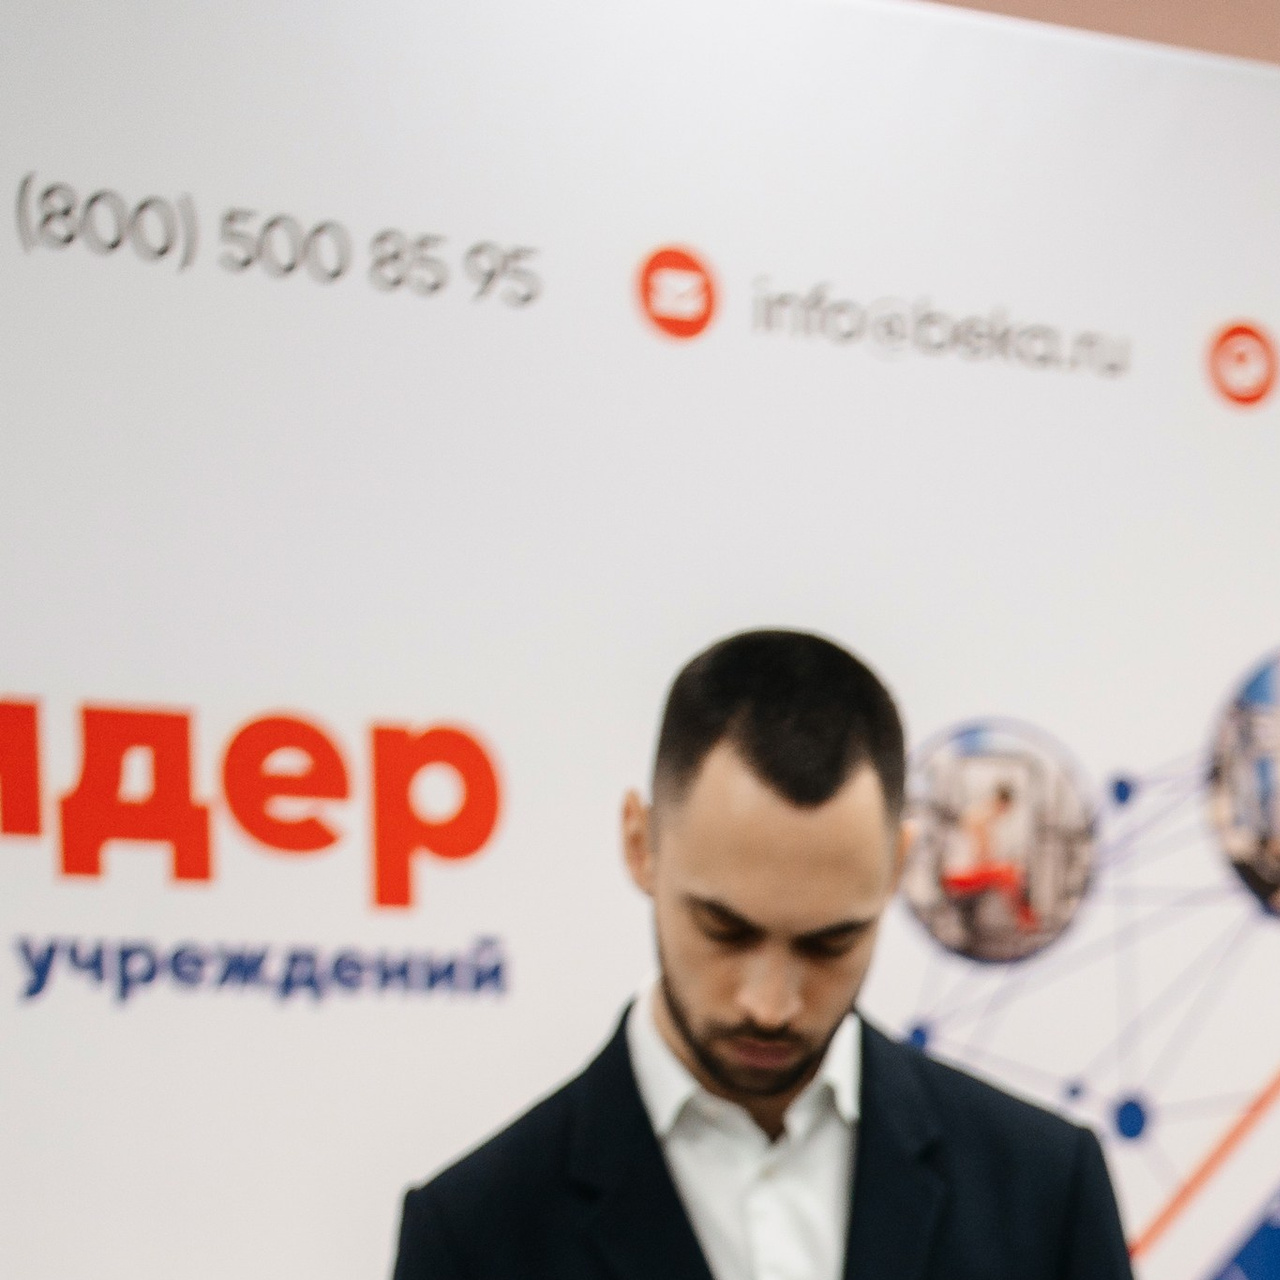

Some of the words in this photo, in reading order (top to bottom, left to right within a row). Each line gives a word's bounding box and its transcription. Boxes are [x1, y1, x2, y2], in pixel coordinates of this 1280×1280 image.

[14, 172, 198, 273] (800)
[219, 206, 351, 286] 500
[369, 227, 449, 298] 85
[464, 240, 543, 310] 95
[750, 278, 1131, 379] info@beka.ru
[18, 932, 509, 1003] учреждений
